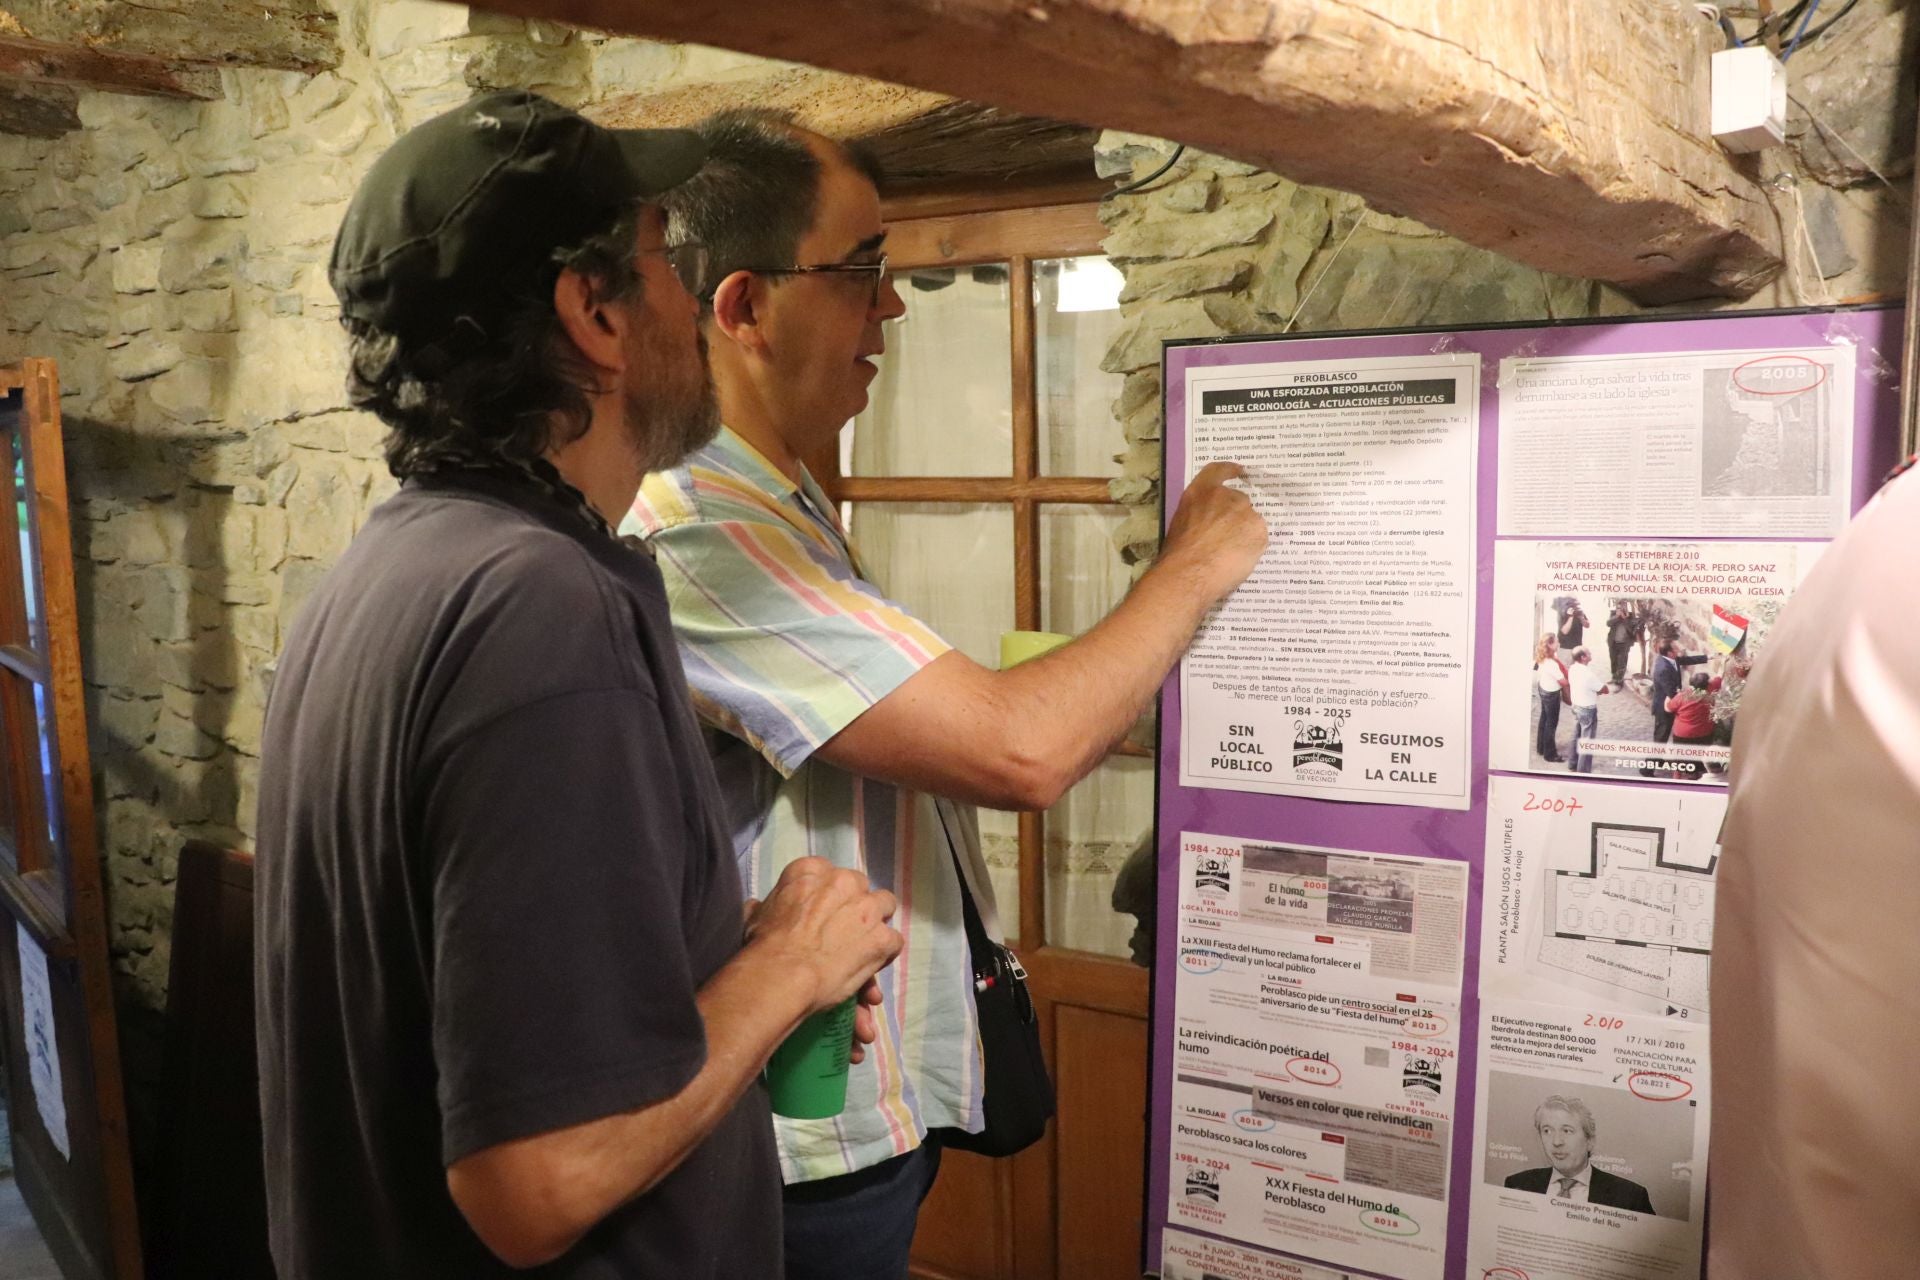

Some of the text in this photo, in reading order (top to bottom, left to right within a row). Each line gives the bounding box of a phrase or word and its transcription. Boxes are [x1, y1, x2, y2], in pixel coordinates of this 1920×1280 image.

[1294, 372, 1358, 383] PEROBLASCO
[1516, 372, 1691, 389] Una anciana logra salvar la vida tras
[1761, 366, 1807, 380] 2005
[1250, 381, 1404, 399] UNA ESFORZADA REPOBLACIÓN
[1515, 391, 1579, 402] derrumbarse
[1589, 391, 1601, 399] su
[1604, 389, 1625, 399] lado
[1628, 388, 1636, 398] la
[1638, 388, 1669, 401] iglesia
[1215, 394, 1444, 413] BREVE CRONOLOGÍA ACTUACIONES PÚBLICAS
[1624, 552, 1673, 560] SETIEMBRE
[1676, 552, 1700, 560] 2.010
[1546, 562, 1573, 570] VISITA
[1576, 562, 1630, 570] PRESIDENTE
[1633, 562, 1646, 570] DE
[1648, 563, 1660, 571] LA
[1712, 564, 1746, 572] PEDRO
[1748, 564, 1776, 572] SANZ
[1554, 573, 1595, 581] ALCALDE
[1601, 573, 1613, 581] DE
[1680, 574, 1724, 582] CLAUDIO
[1728, 575, 1766, 584] GARCIA
[1537, 584, 1784, 596] PROMESA CENTRO SOCIAL EN LA DERRUIDA IGLESIA
[1212, 682, 1247, 693] Despues
[1249, 683, 1259, 691] de
[1262, 684, 1288, 693] tantos
[1290, 685, 1311, 694] años
[1314, 686, 1324, 694] de
[1327, 686, 1379, 699] imaginación
[1382, 691, 1387, 699] y
[1284, 706, 1351, 718] 1984 2025
[1229, 725, 1254, 736] SIN
[1360, 732, 1444, 748] SEGUIMOS
[1220, 742, 1264, 755] LOCAL
[1620, 745, 1666, 755] MARCELINA
[1211, 757, 1273, 773] PÚBLICO
[1391, 753, 1411, 764] EN
[1615, 759, 1696, 772] PEROBLASCO
[1365, 769, 1437, 783] LA CALLE
[1523, 793, 1583, 816] 2007
[1269, 882, 1305, 897] El humo
[1498, 818, 1513, 964] PLANTA SALÓN USOS MÚLTIPLES
[1510, 850, 1524, 934] Peroblasco La rioja
[1265, 895, 1308, 909] de la vida
[1181, 936, 1360, 969] La XXIII Fiesta del Humo reclama fortalecer el
[1261, 985, 1306, 1001] Peroblasco
[1308, 992, 1327, 1004] pide
[1342, 998, 1370, 1008] centro
[1372, 1001, 1397, 1013] social
[1398, 1006, 1410, 1015] en
[1412, 1007, 1420, 1016] el
[1422, 1009, 1432, 1018] 25
[1500, 1016, 1534, 1028] Ejecutivo
[1536, 1022, 1566, 1032] regional
[1492, 1025, 1595, 1045] Iberdrola destinan 800.000
[1179, 1027, 1329, 1062] La reivindicación poética del
[1179, 1041, 1209, 1054] humo
[1491, 1035, 1512, 1043] euros
[1519, 1037, 1525, 1045] la
[1526, 1040, 1552, 1050] mejora
[1554, 1041, 1565, 1050] del
[1567, 1043, 1596, 1055] servicio
[1644, 1038, 1656, 1046] XII
[1665, 1040, 1685, 1049] 2010
[1491, 1043, 1522, 1053] eléctrico
[1534, 1049, 1556, 1059] zonas
[1557, 1052, 1583, 1062] rurales
[1614, 1047, 1696, 1065] FINANCIACIÓN PARA
[1303, 1065, 1327, 1076] 2014
[1616, 1057, 1649, 1068] CENTRO
[1651, 1062, 1693, 1073] CULTURAL
[1258, 1090, 1433, 1131] Versos en color que reivindican
[1178, 1124, 1307, 1160] Peroblasco saca los colores
[1265, 1191, 1326, 1214] Peroblasco
[1266, 1176, 1400, 1215] XXX Fiesta del Humo de
[1550, 1199, 1591, 1213] Consejero
[1594, 1205, 1638, 1222] Presidencia
[1566, 1212, 1590, 1223] Emilio
[1592, 1216, 1605, 1225] del
